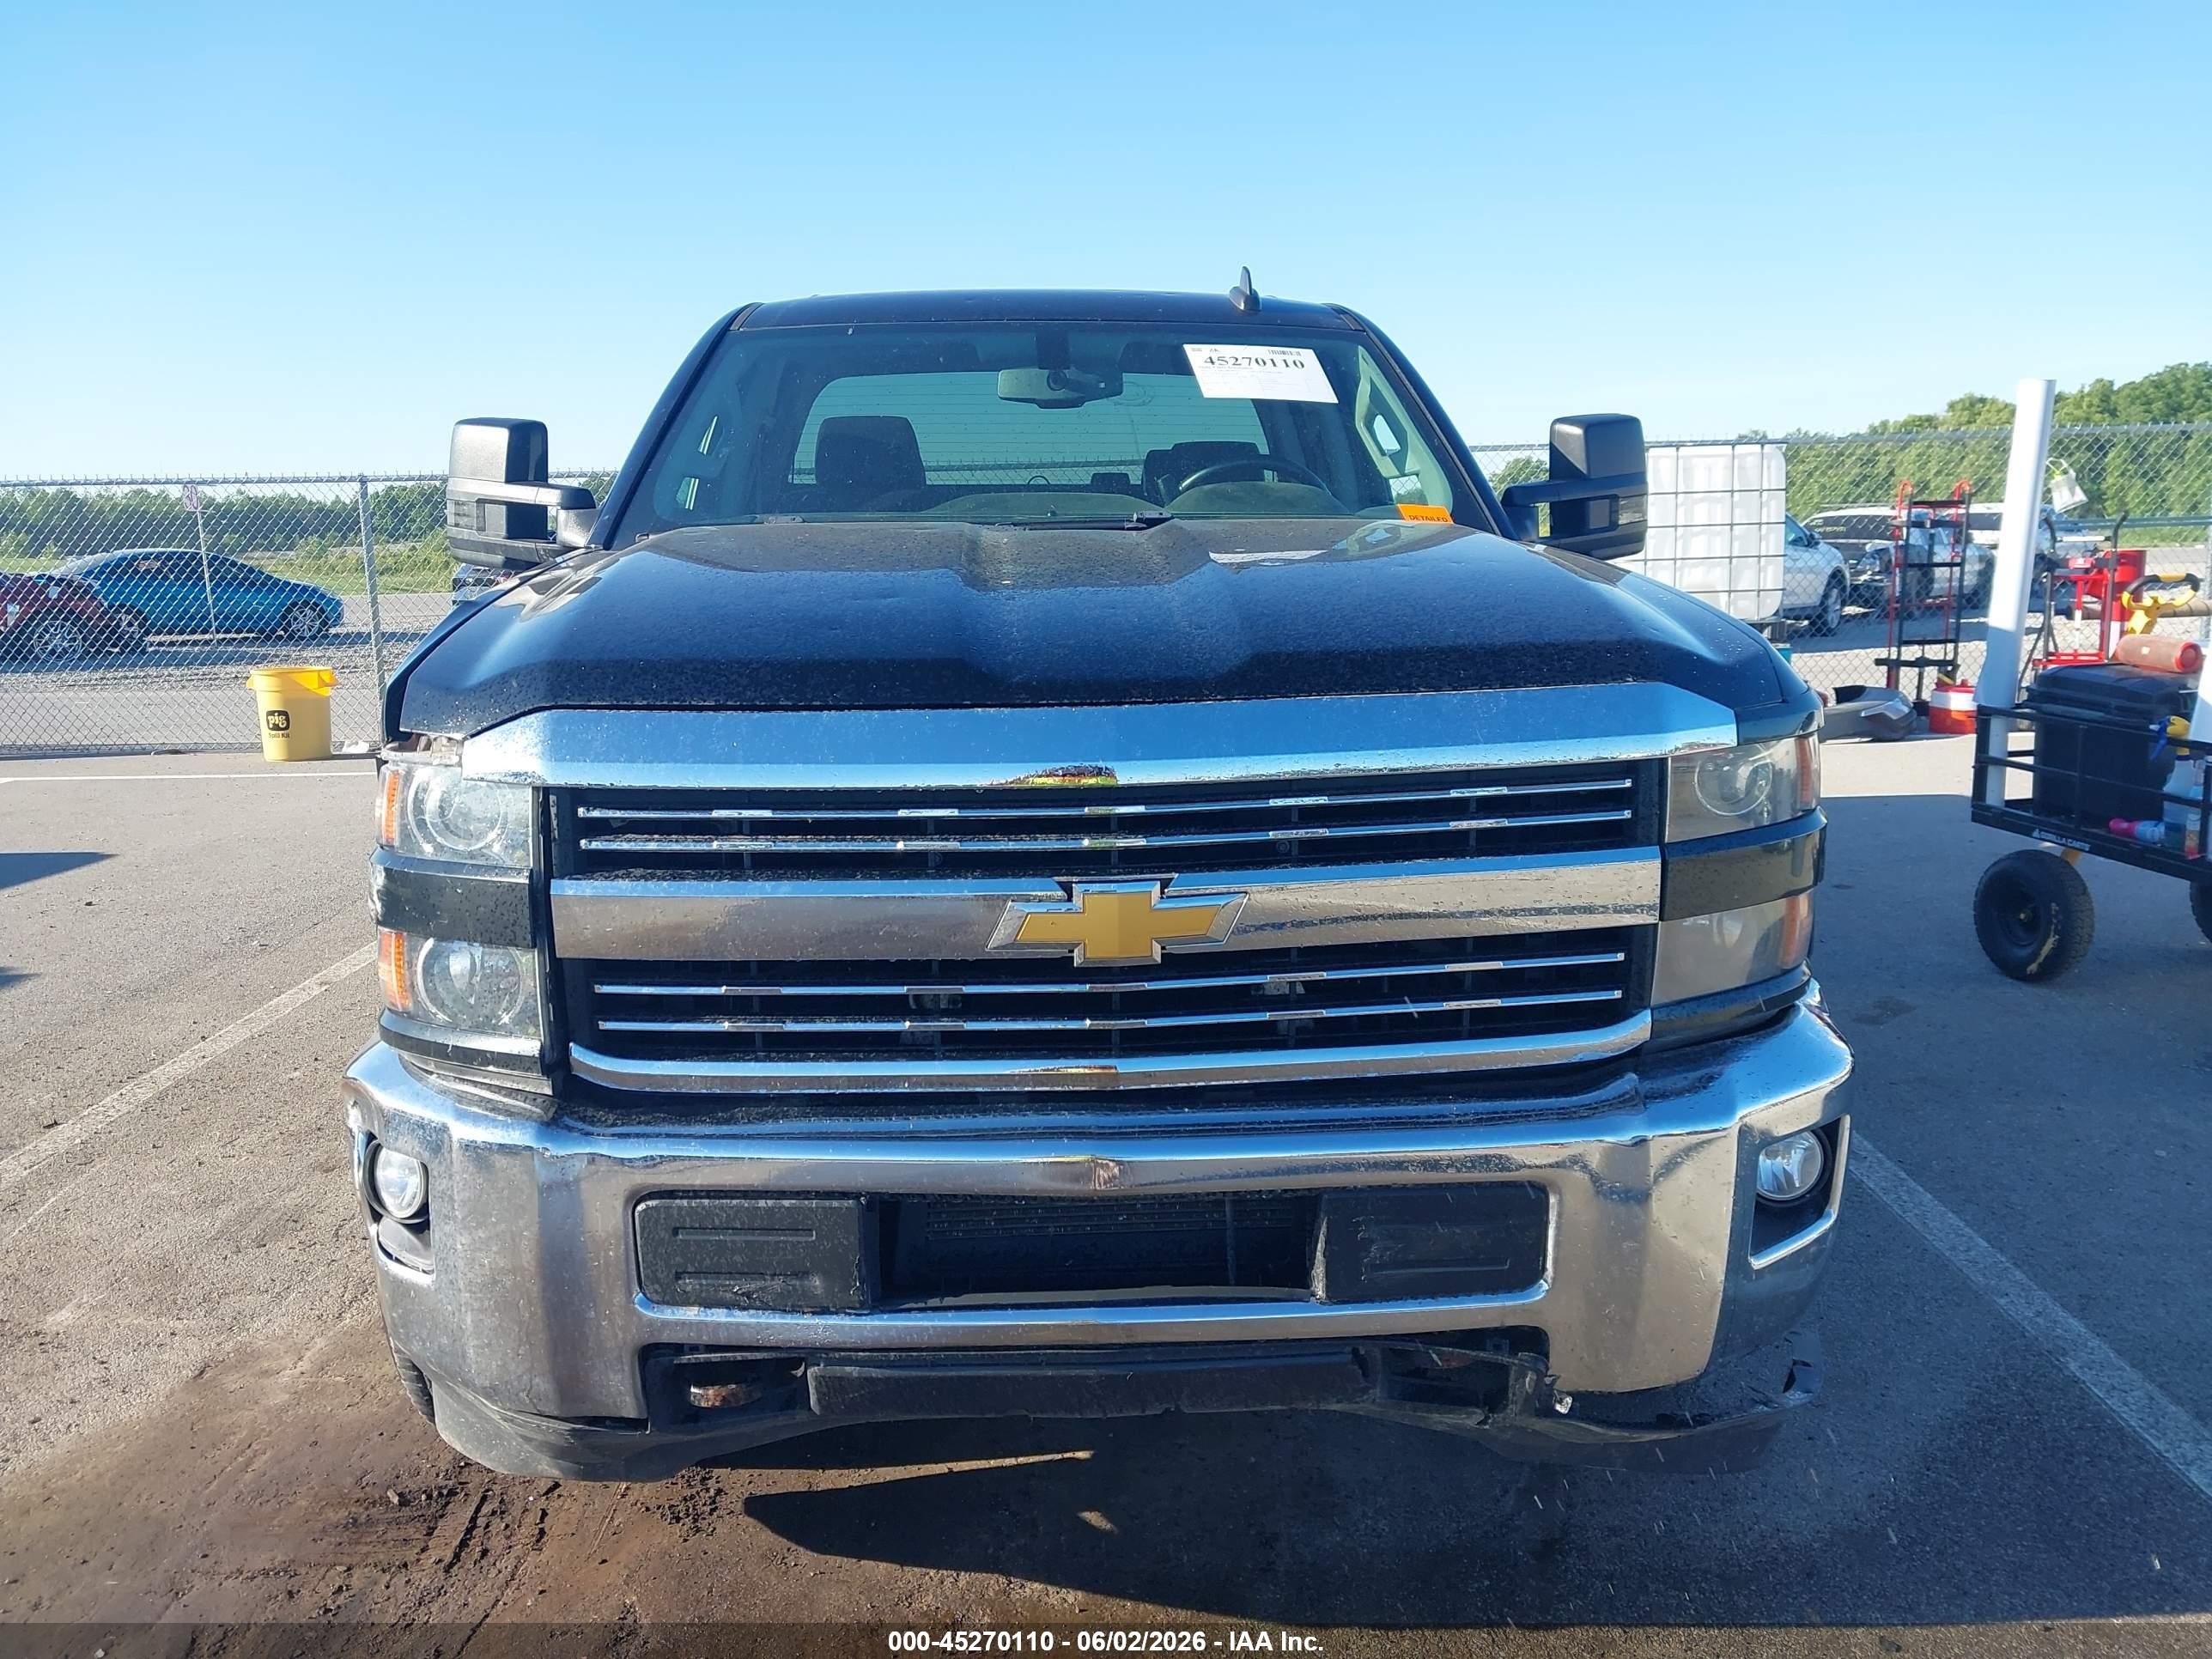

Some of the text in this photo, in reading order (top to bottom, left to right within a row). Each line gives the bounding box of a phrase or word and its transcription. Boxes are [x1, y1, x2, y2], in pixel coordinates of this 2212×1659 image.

[1203, 355, 1305, 370] 45270110
[1408, 514, 1449, 523] DETAILED
[267, 712, 287, 728] pig
